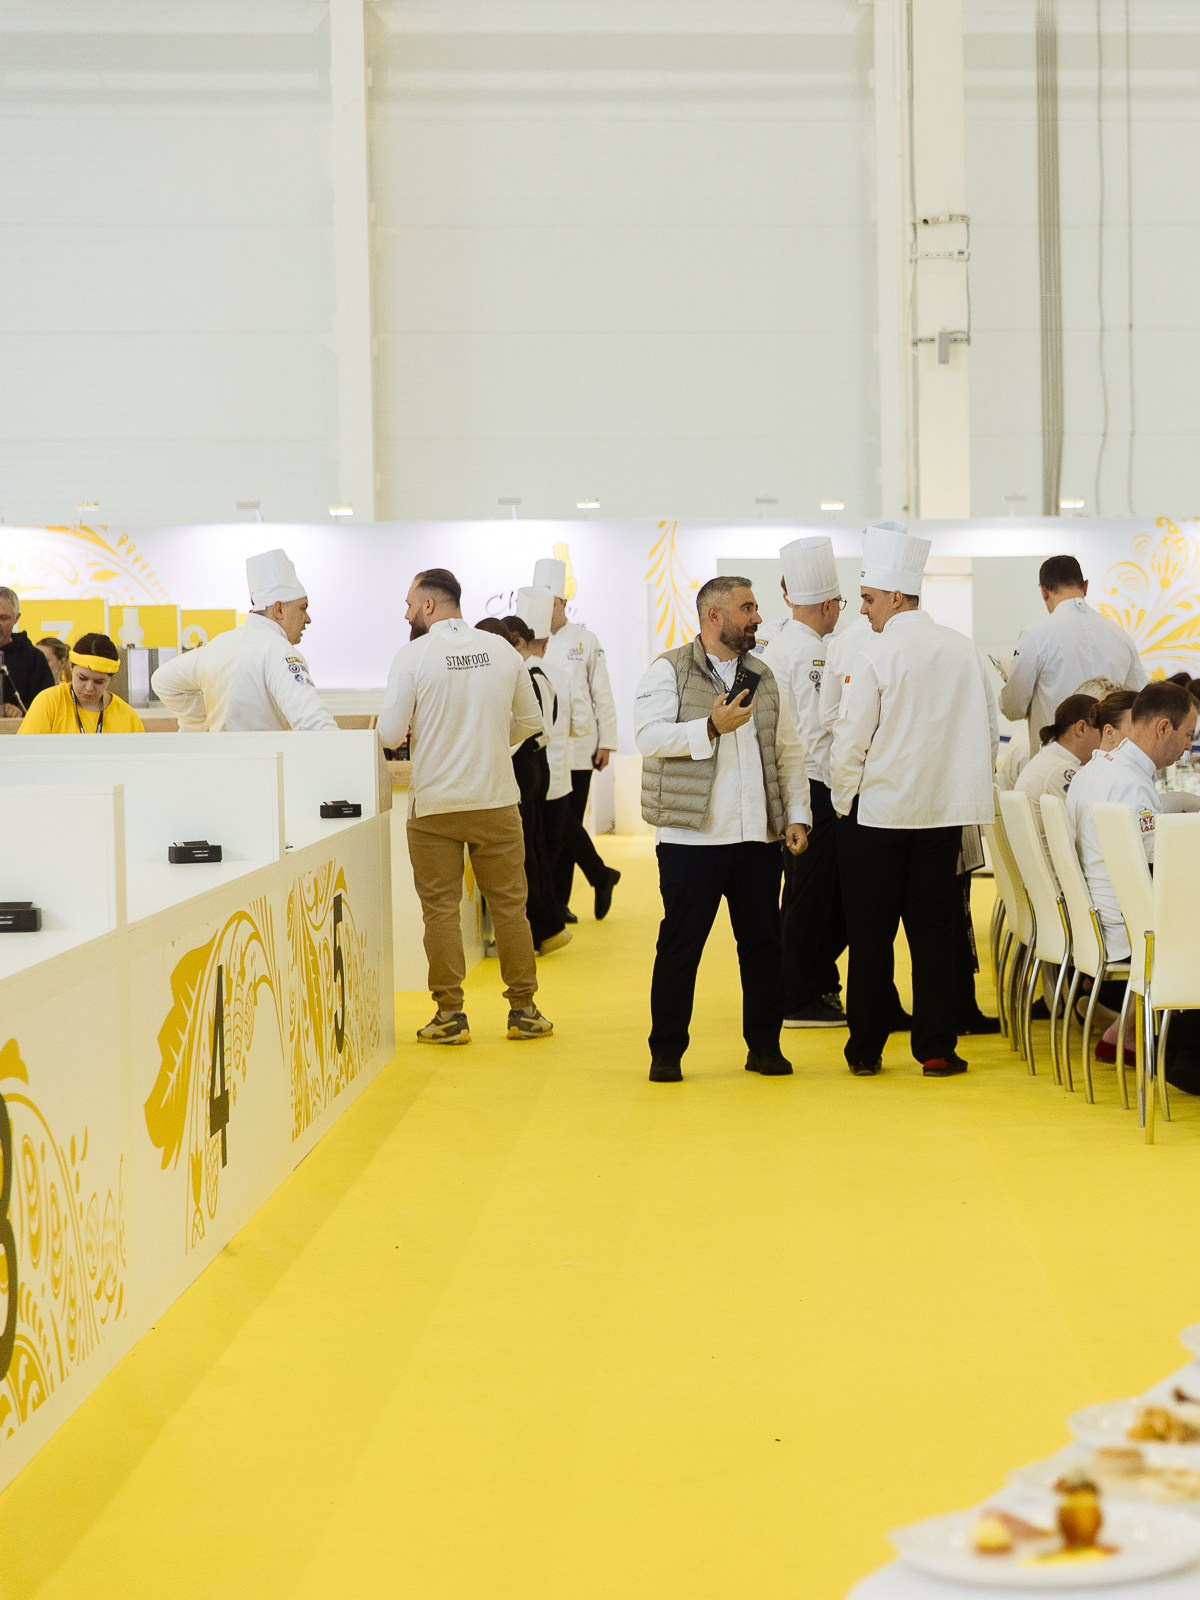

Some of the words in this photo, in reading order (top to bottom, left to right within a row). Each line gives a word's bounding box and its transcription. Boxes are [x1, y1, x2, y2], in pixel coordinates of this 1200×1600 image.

[445, 652, 490, 667] STANFOOD
[333, 893, 345, 1055] 5
[209, 964, 230, 1169] 4
